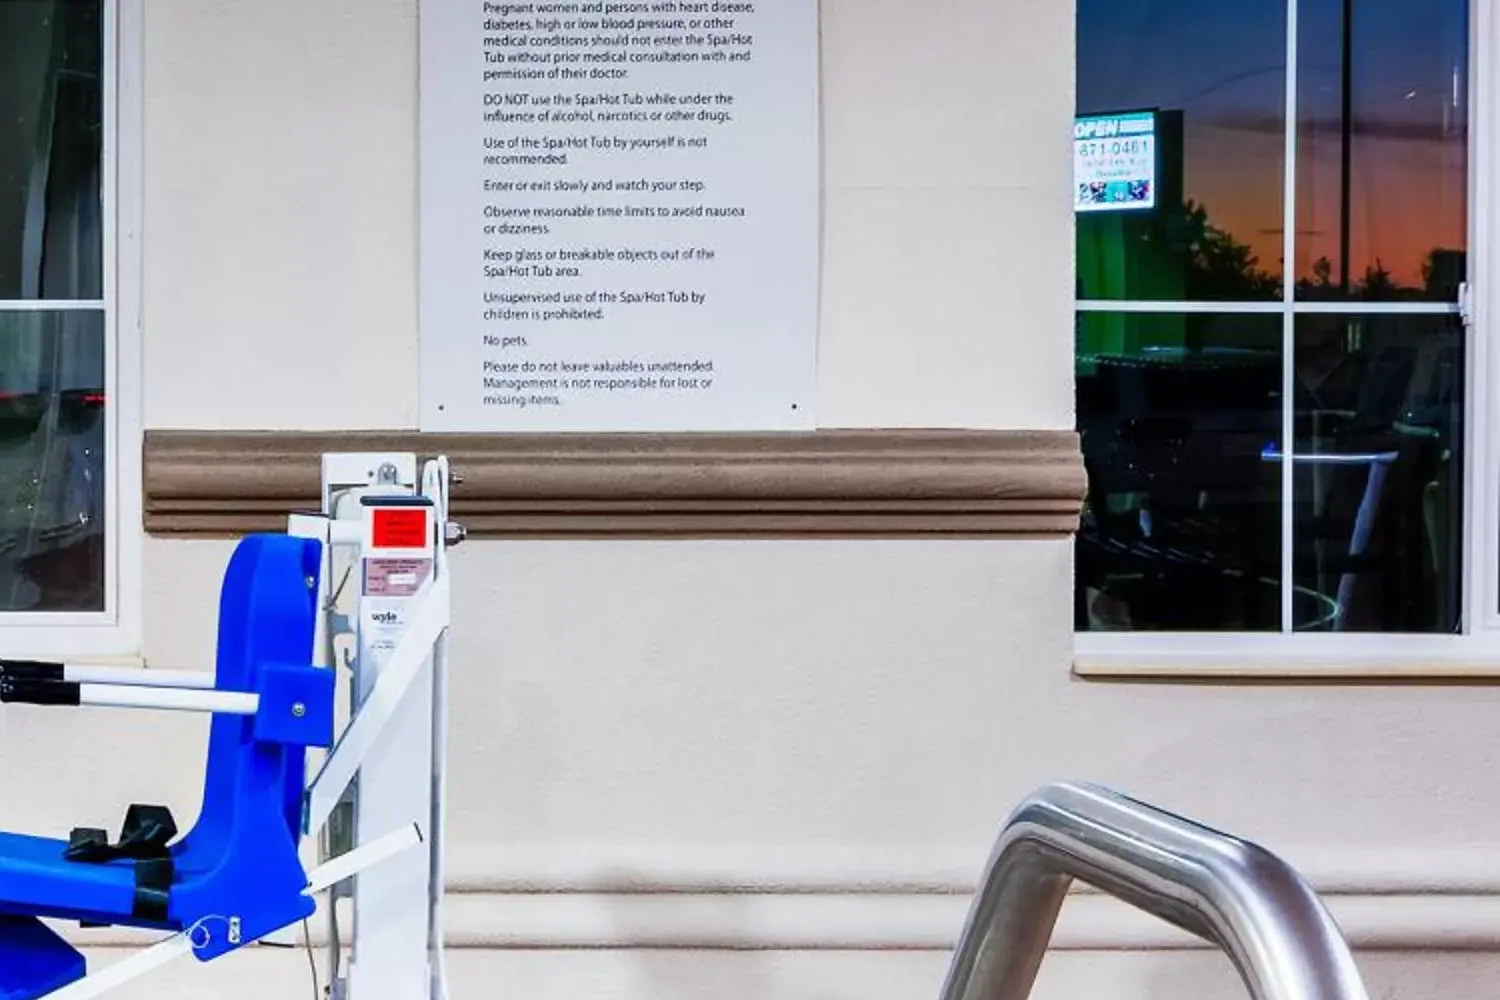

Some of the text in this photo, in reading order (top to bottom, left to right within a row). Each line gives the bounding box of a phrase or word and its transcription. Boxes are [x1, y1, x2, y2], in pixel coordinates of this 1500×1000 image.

[484, 2, 533, 16] Pregnant
[536, 4, 578, 13] women
[581, 1, 602, 13] and
[605, 3, 649, 15] persons
[652, 1, 676, 12] with
[679, 1, 708, 12] heart
[536, 19, 561, 32] high
[564, 21, 575, 30] or
[578, 19, 598, 29] low
[602, 18, 634, 29] blood
[637, 20, 686, 31] pressure,
[689, 20, 701, 29] or
[704, 18, 734, 28] other
[484, 34, 752, 48] medical conditions should not enter the Spa/Hot
[484, 50, 751, 64] Tub without prior medical consultation with and
[484, 68, 544, 81] permission
[548, 67, 559, 79] of
[561, 68, 587, 78] their
[484, 93, 733, 107] DO NOT use the Spa/Hot Tub while under the
[484, 110, 535, 122] influence
[537, 110, 549, 122] of
[650, 112, 662, 121] or
[664, 110, 695, 121] other
[484, 136, 707, 150] Use of the Spa/Hot Tub by yourself is not
[484, 180, 513, 191] Enter
[515, 182, 528, 191] or
[530, 181, 551, 191] exit
[553, 180, 588, 193] slowly
[591, 180, 612, 191] and
[616, 179, 649, 190] watch
[652, 182, 677, 192] your
[484, 205, 744, 217] Observe reasonable time limits to avoid nausea
[484, 226, 496, 234] or
[484, 248, 714, 263] Keep glass or breakable objects out of the
[484, 265, 529, 278] Spa/Hot
[532, 265, 552, 276] Tub
[484, 291, 705, 304] Unsupervised use of the Spa/Hot Tub by
[484, 308, 604, 320] children is prohibited.
[484, 336, 500, 346] No
[484, 361, 518, 372] Please
[521, 361, 536, 372] do
[539, 361, 558, 372] not
[561, 361, 590, 372] leave
[593, 360, 644, 372] valuables
[484, 376, 712, 391] Management is not responsible for lost or
[484, 396, 526, 408] missing
